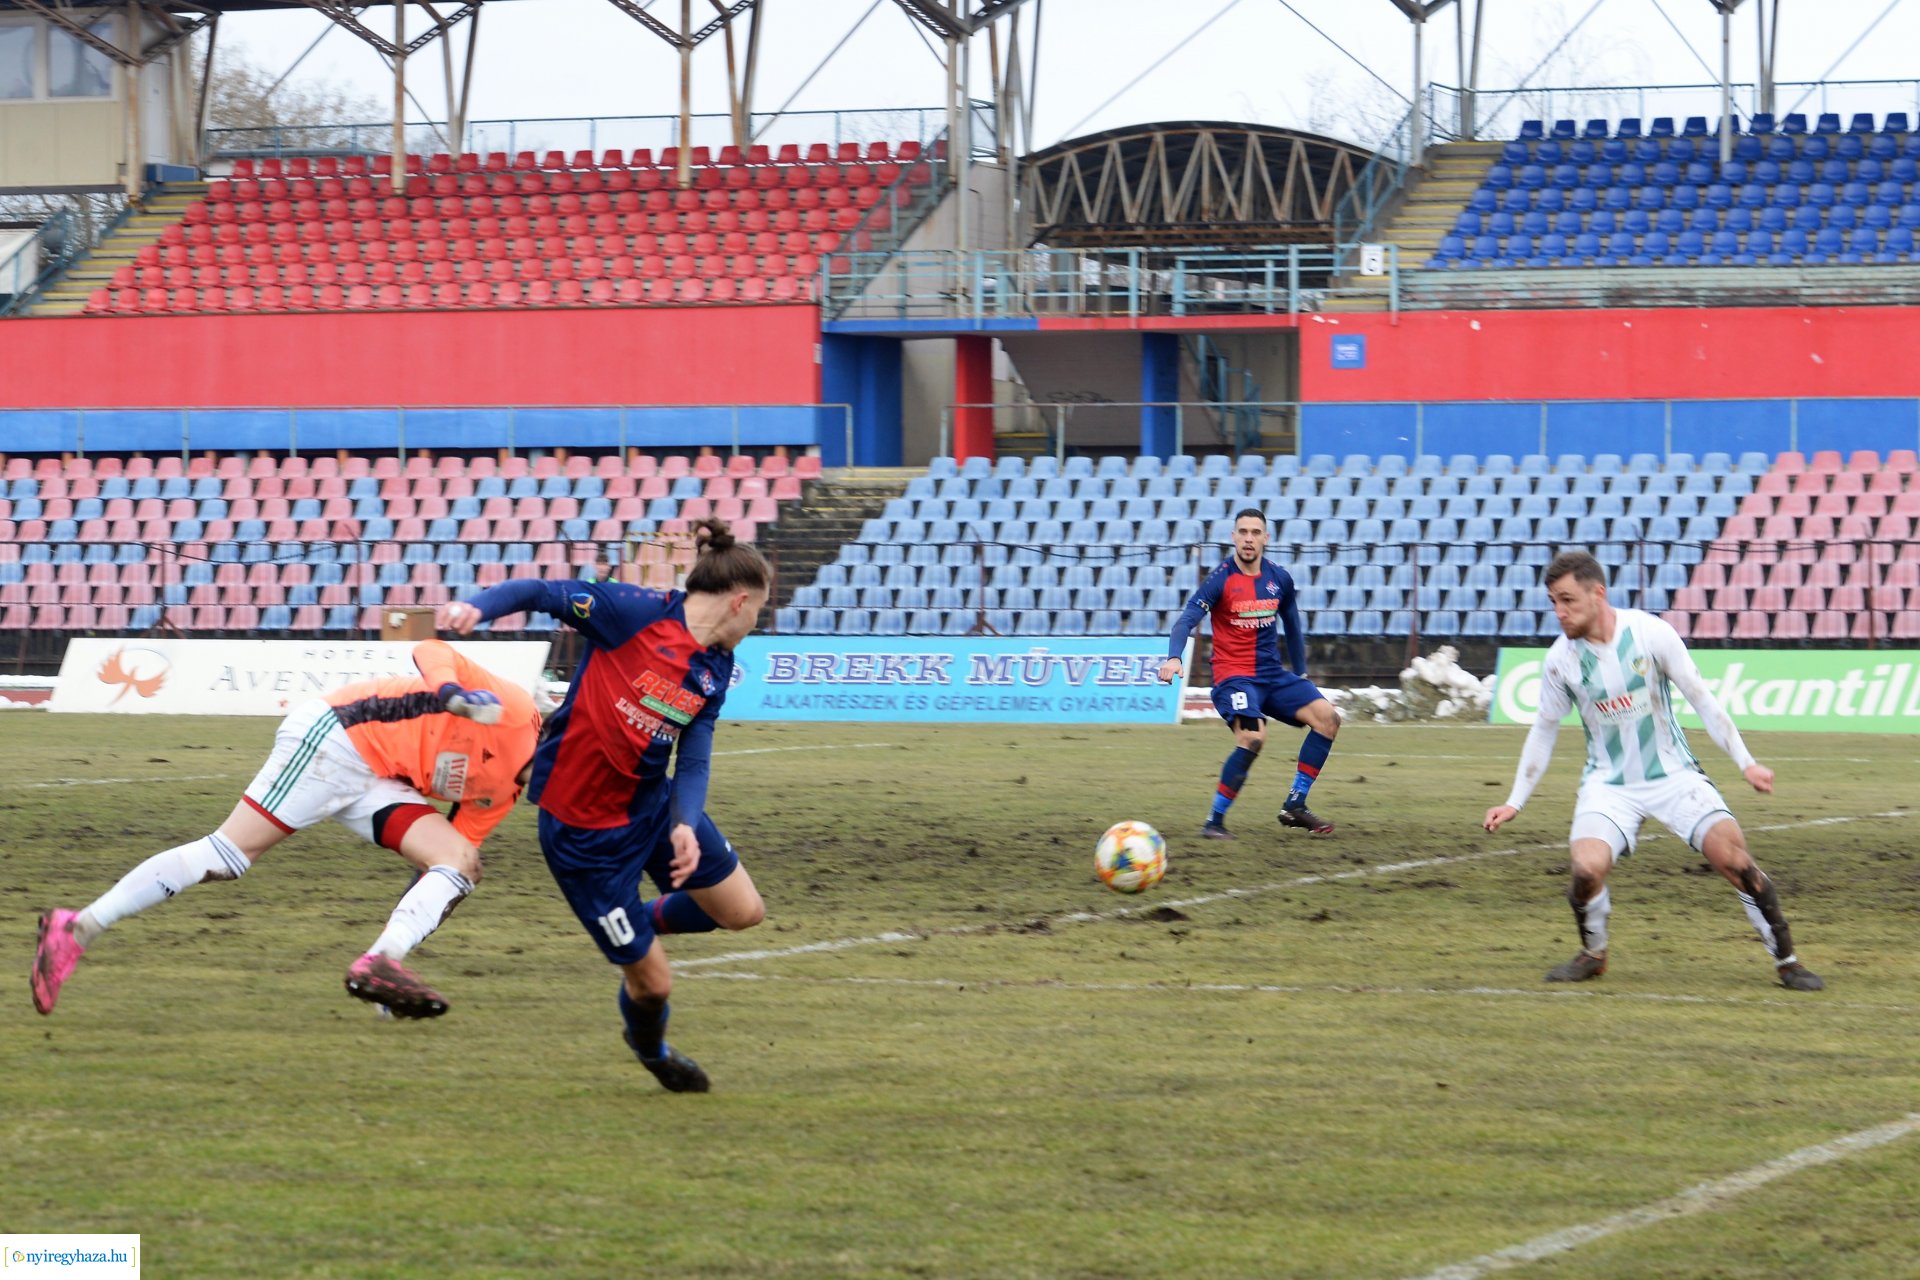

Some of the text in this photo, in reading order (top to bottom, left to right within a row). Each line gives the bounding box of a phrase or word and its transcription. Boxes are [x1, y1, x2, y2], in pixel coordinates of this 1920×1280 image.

[303, 649, 397, 660] HOTEL
[762, 652, 954, 685] BREKK
[761, 690, 1168, 713] ALKATRÉSZEK ÉS GÉPELEMEK GYÁRTÁSA
[598, 906, 636, 948] 10
